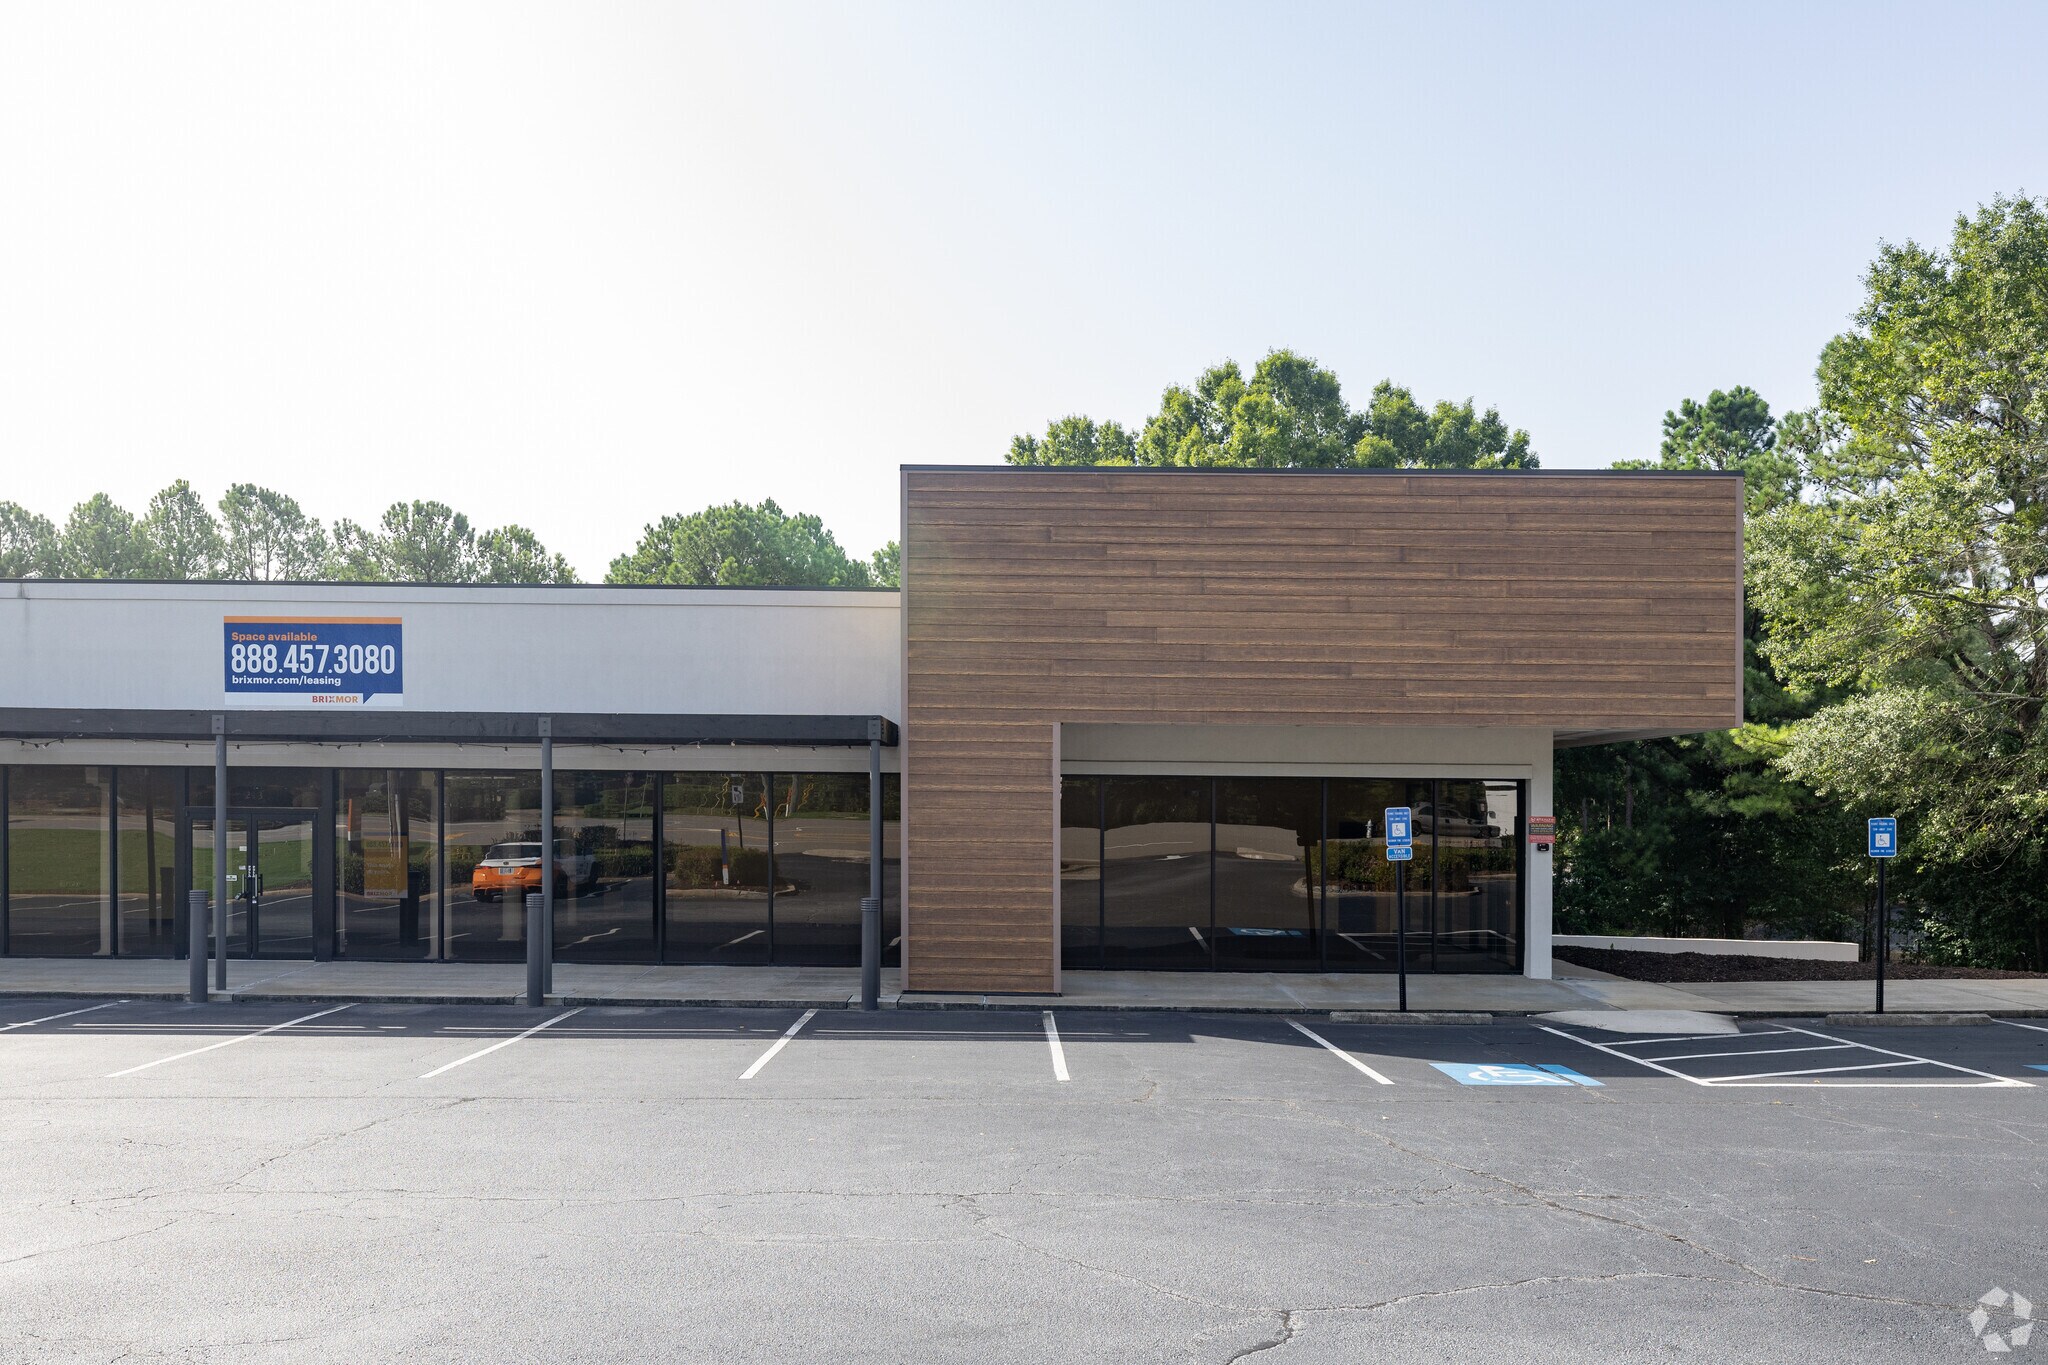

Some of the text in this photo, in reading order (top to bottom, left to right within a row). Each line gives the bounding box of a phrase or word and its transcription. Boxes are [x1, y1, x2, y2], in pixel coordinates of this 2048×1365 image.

[231, 632, 318, 643] Space available
[231, 643, 395, 674] 888.457.3080
[232, 675, 341, 687] brixmor.com/leasing
[312, 695, 358, 704] BRIXMOR
